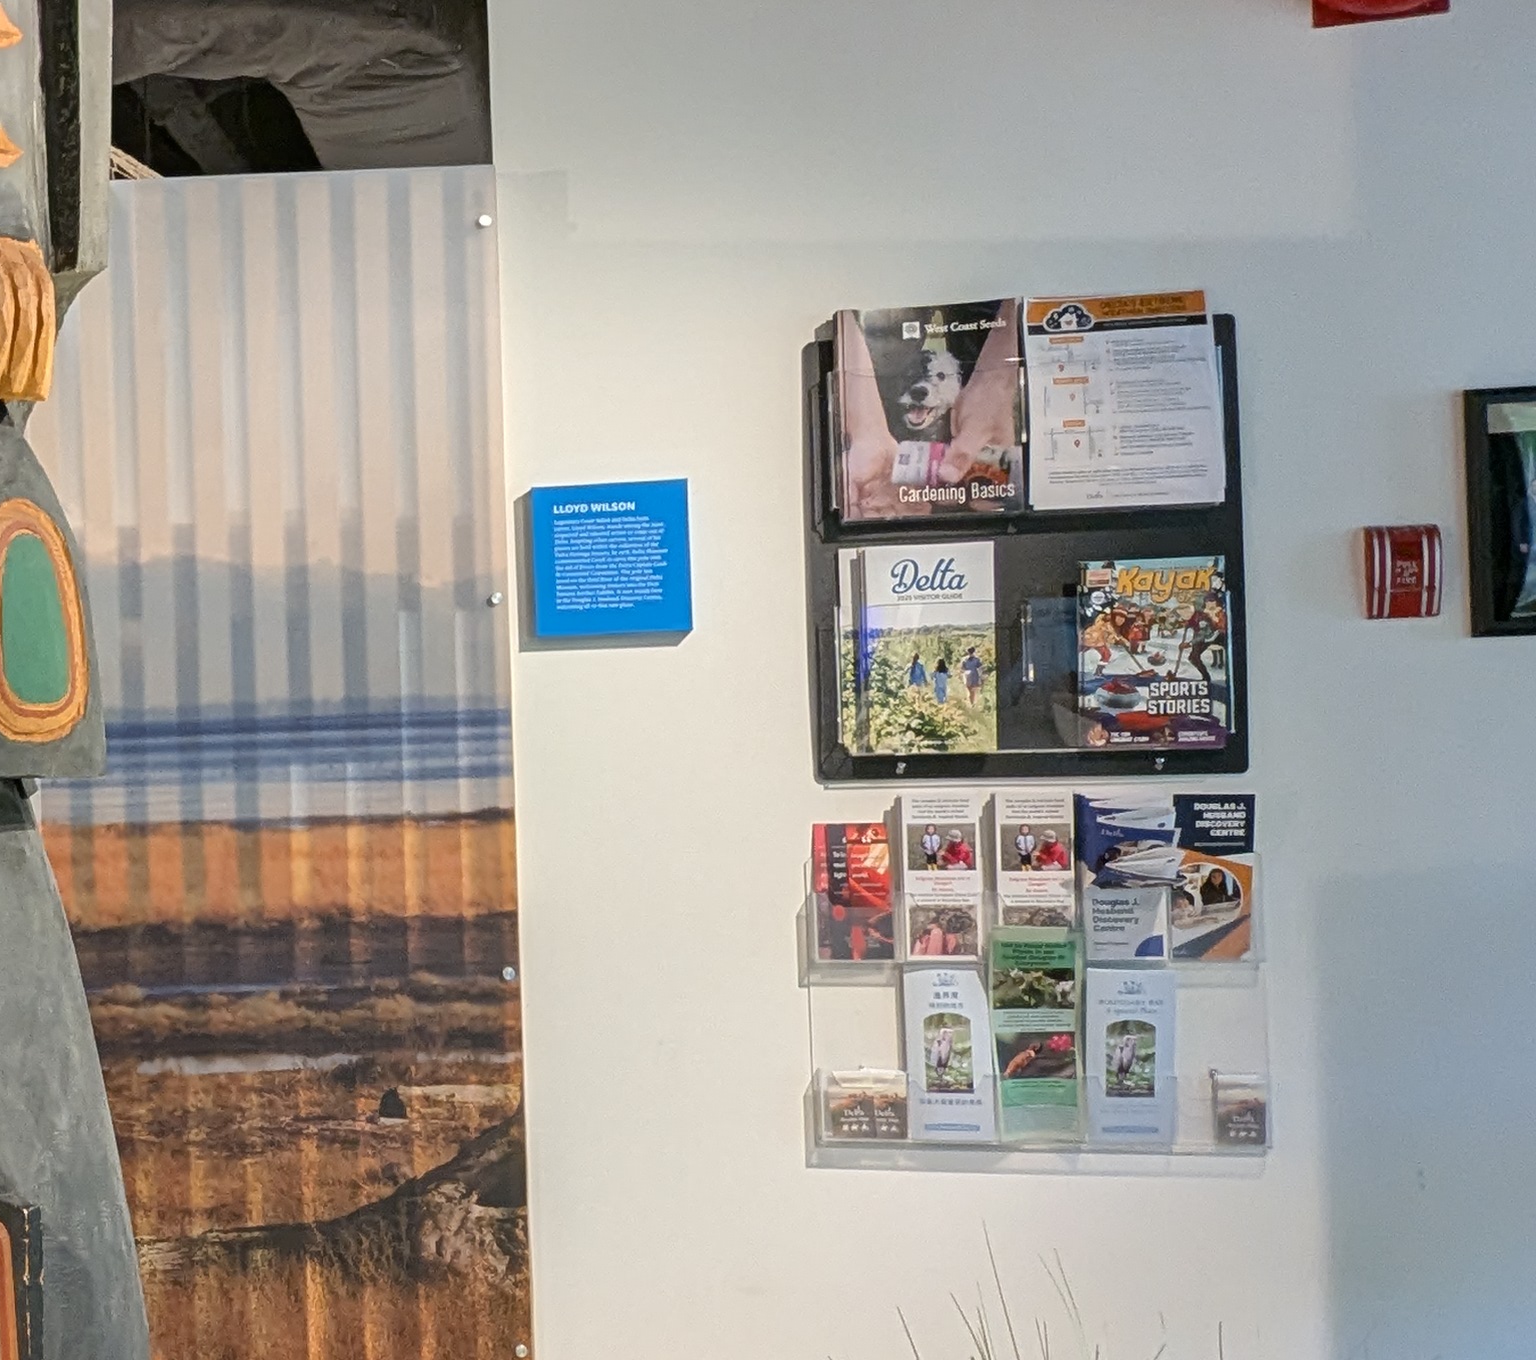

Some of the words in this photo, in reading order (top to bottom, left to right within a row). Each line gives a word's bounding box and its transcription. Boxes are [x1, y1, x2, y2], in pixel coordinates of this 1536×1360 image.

[950, 322, 978, 331] Coast
[980, 318, 1006, 329] Seeds
[899, 485, 966, 504] Gardening
[971, 482, 1015, 499] Basics
[553, 503, 588, 514] LLOYD
[591, 501, 635, 512] WILSON
[891, 558, 968, 594] Delta
[1150, 681, 1208, 696] SPORTS
[1148, 699, 1210, 714] STORIES
